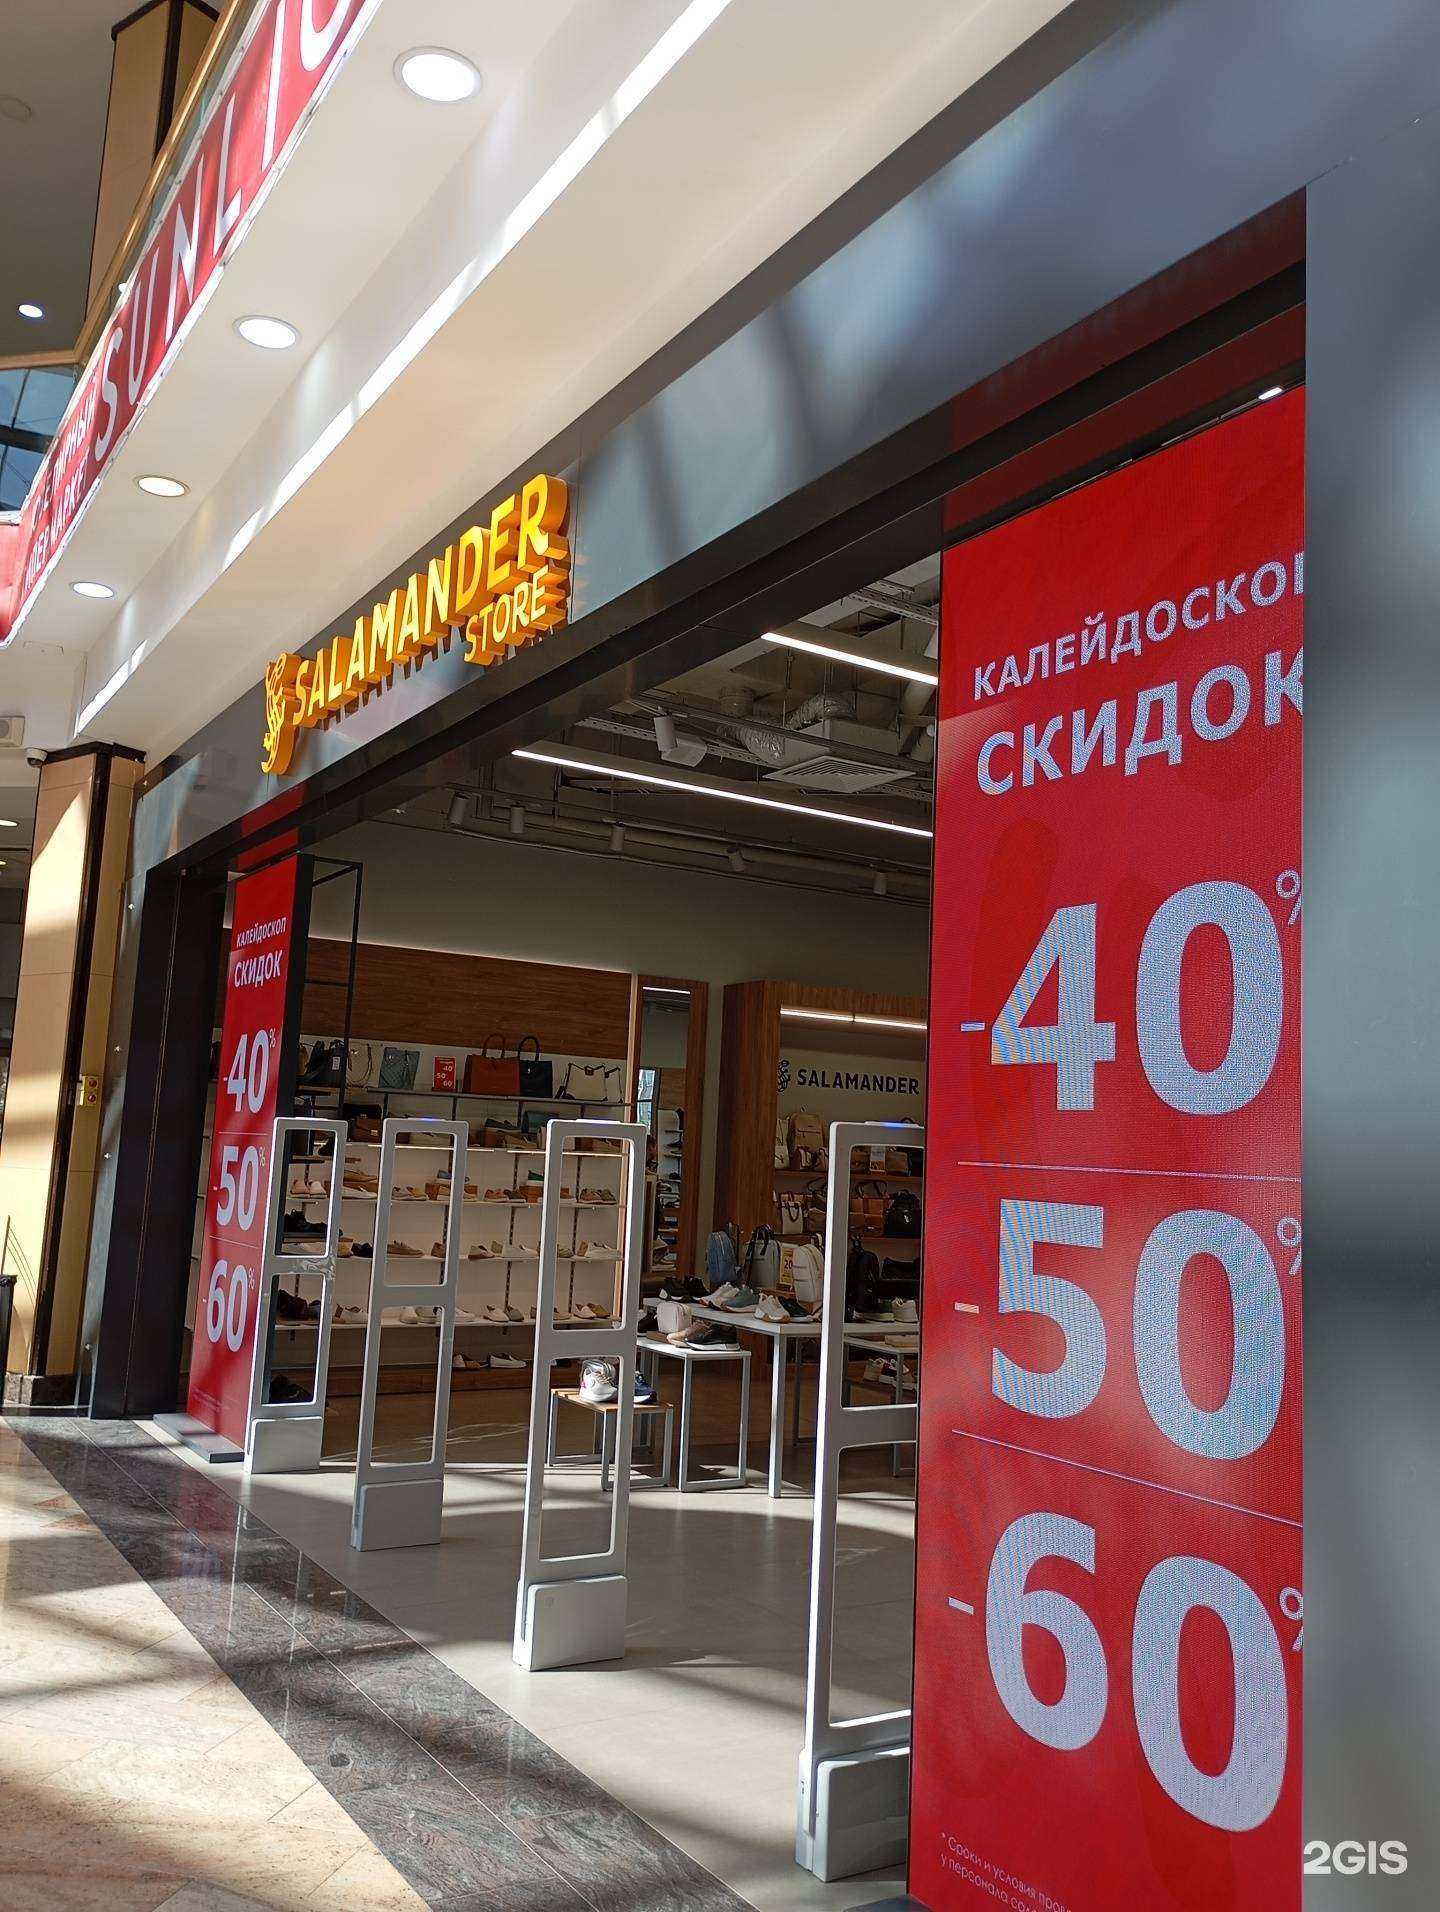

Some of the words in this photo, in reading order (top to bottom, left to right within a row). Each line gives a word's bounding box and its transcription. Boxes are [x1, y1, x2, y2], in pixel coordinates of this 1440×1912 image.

[292, 472, 562, 726] SALAMANDER
[463, 565, 555, 664] STORE
[976, 645, 1304, 796] СКИДОК
[236, 916, 287, 948] КАЛЕЙДОСКОП
[233, 949, 284, 989] СКИДОК
[796, 1068, 920, 1096] SALAMANDER
[948, 1858, 1009, 1903] персонала
[993, 1865, 1037, 1899] условия
